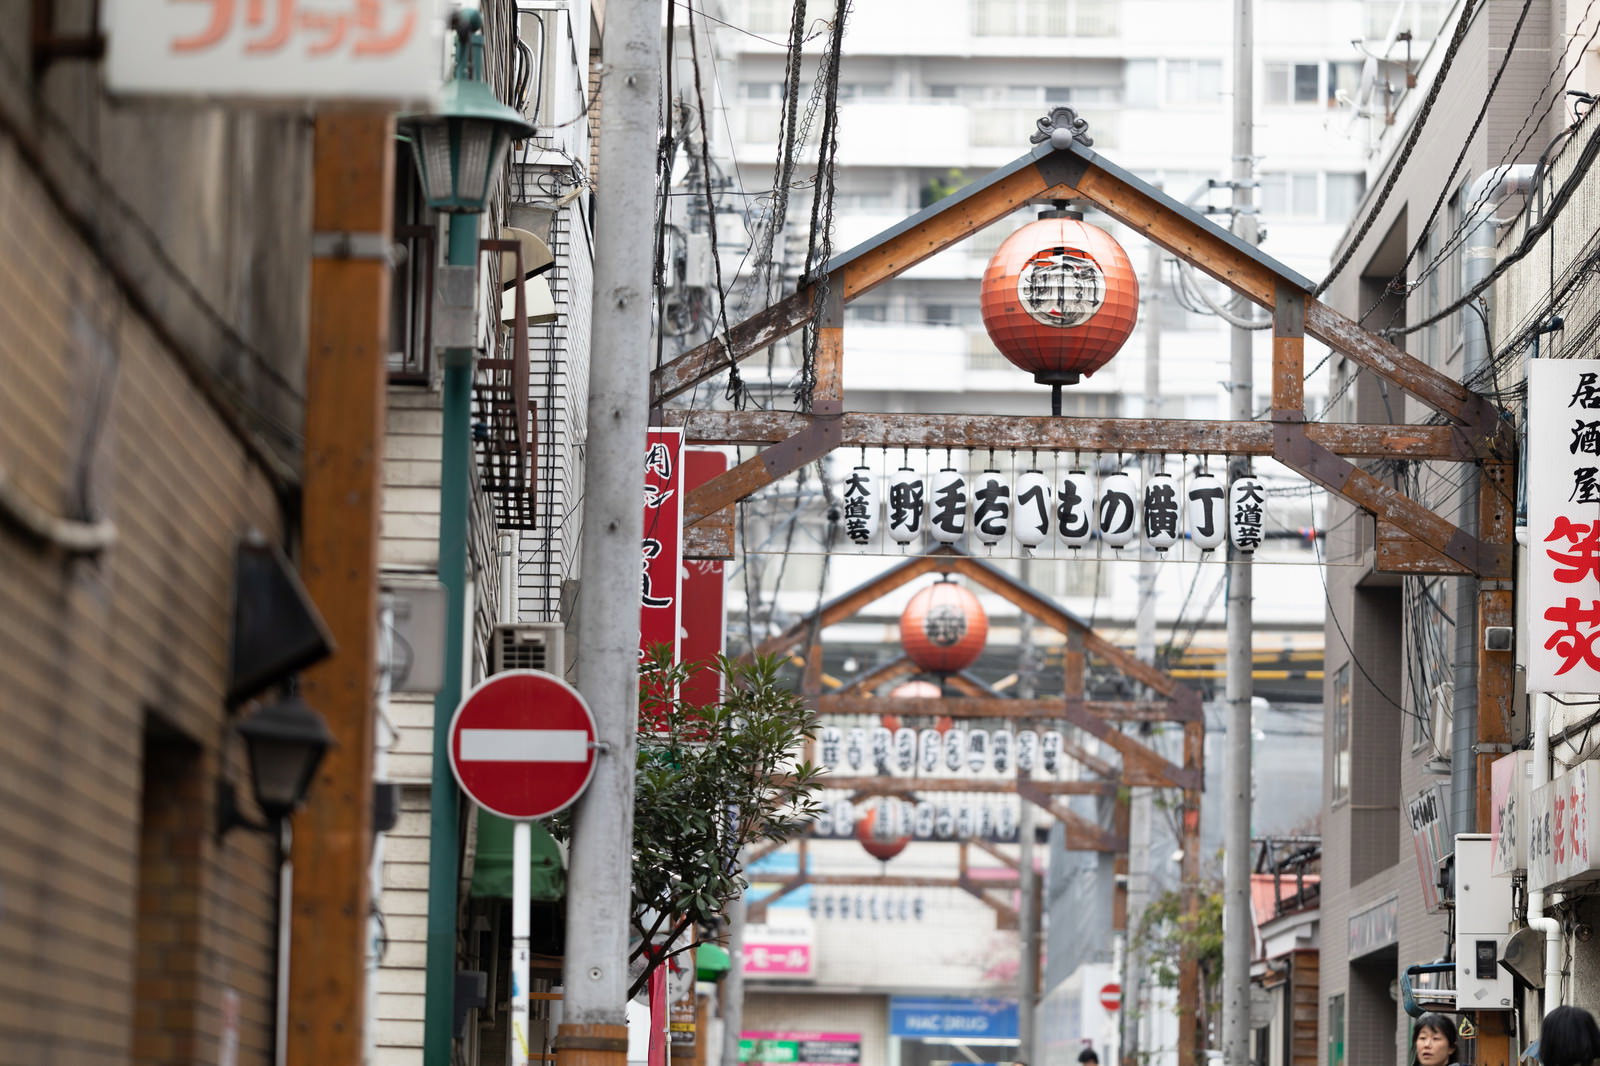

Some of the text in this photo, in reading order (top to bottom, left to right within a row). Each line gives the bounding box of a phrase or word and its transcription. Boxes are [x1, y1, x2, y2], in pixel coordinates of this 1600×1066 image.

[1568, 372, 1600, 505] 居酒屋
[844, 473, 871, 540] 大道芸
[889, 479, 1226, 539] 野毛たべもの横丁
[1234, 481, 1264, 548] 大道芸
[743, 947, 808, 969] モール
